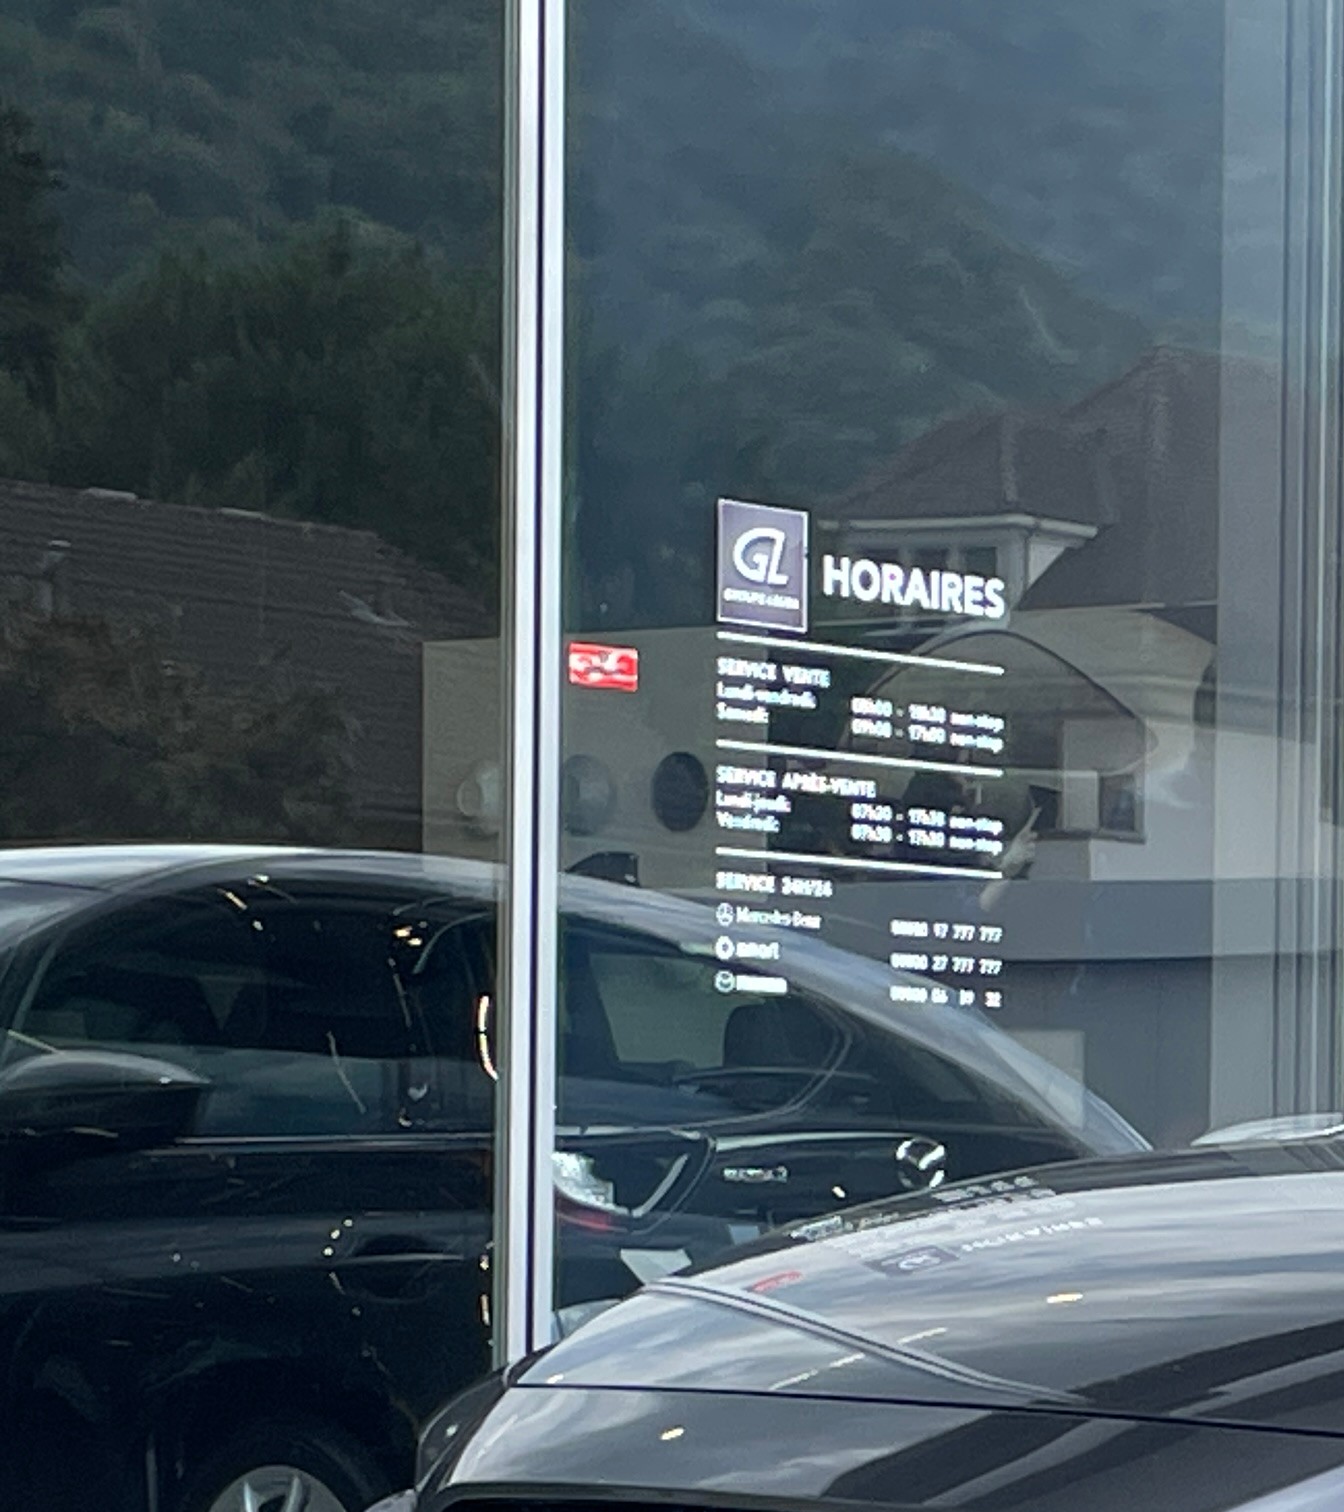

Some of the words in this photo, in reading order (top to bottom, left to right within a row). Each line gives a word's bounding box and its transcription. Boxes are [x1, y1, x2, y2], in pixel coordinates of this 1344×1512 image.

[733, 527, 789, 585] GL
[823, 555, 1005, 618] HORAIRES
[716, 656, 777, 681] SERVICE
[782, 665, 831, 689] VENTE
[715, 765, 777, 788] SERVICE
[716, 871, 776, 894] SERVICE
